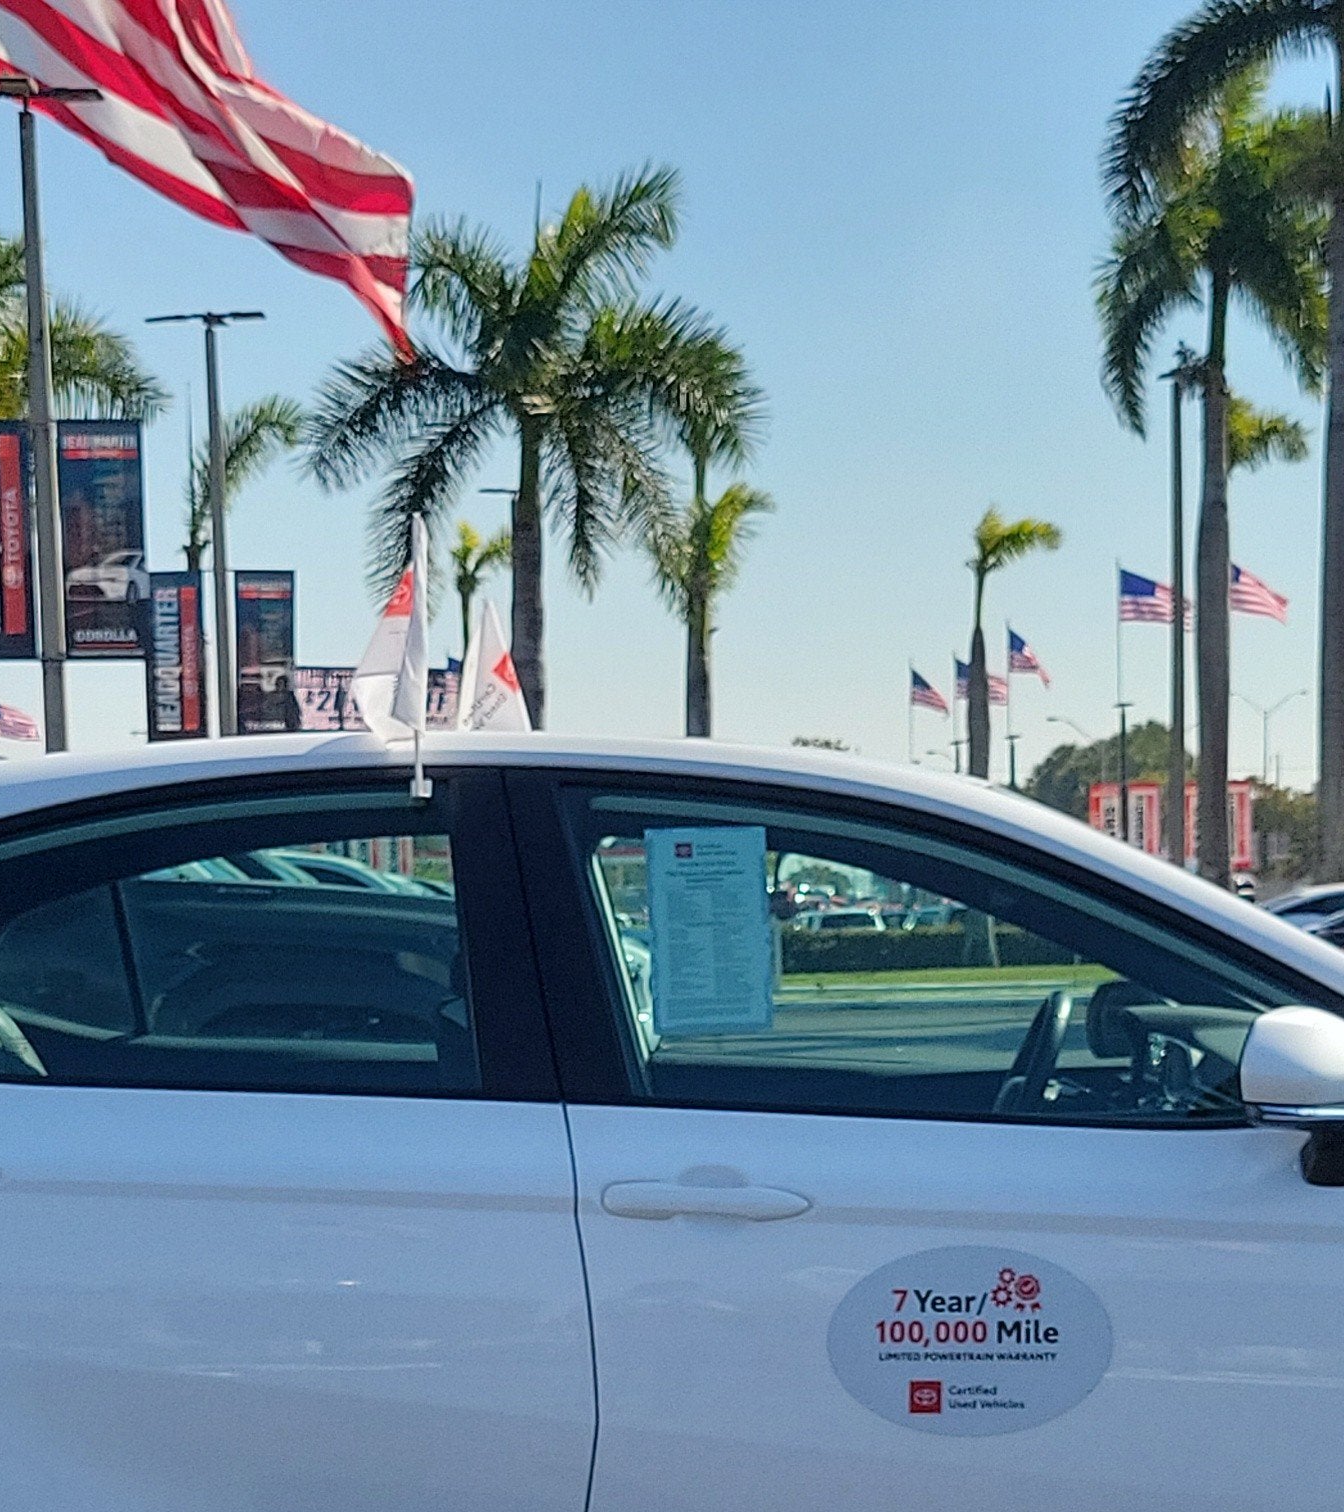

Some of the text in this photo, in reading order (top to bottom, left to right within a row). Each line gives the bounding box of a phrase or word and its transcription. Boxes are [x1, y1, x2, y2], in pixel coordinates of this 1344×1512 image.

[2, 488, 20, 566] TOYOTA
[154, 588, 182, 731] HEADQUARTER
[892, 1289, 988, 1315] 7 Year/
[875, 1319, 1059, 1347] 100,000 Mile
[879, 1352, 1058, 1361] LIMITED POWERTRAIN WARRANTY
[949, 1384, 997, 1395] Certified
[949, 1400, 1025, 1409] Used Vehicles
